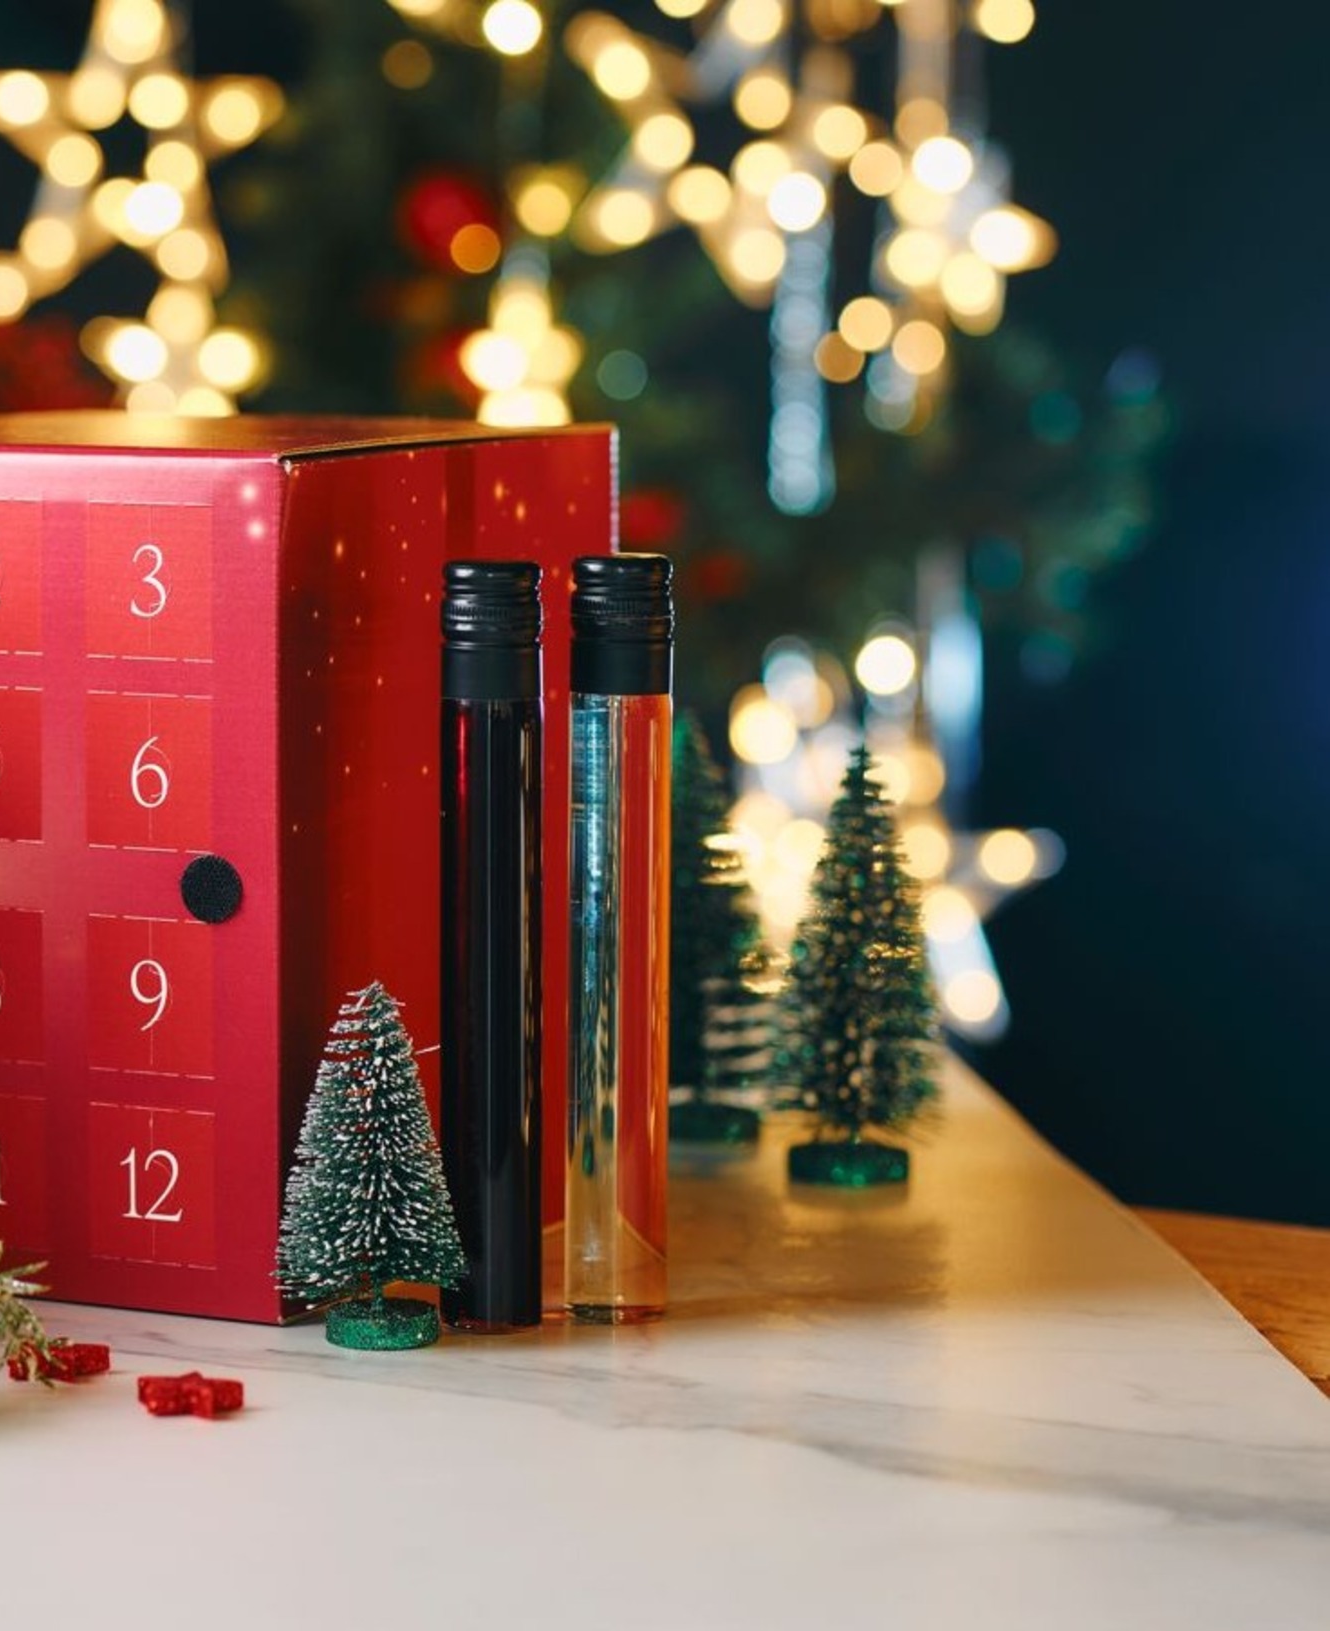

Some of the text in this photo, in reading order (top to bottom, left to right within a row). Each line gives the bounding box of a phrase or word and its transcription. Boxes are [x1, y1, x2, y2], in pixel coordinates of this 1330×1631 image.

[130, 545, 168, 618] 3
[130, 736, 169, 808] 6
[130, 960, 168, 1031] 9
[120, 1147, 183, 1223] 12
